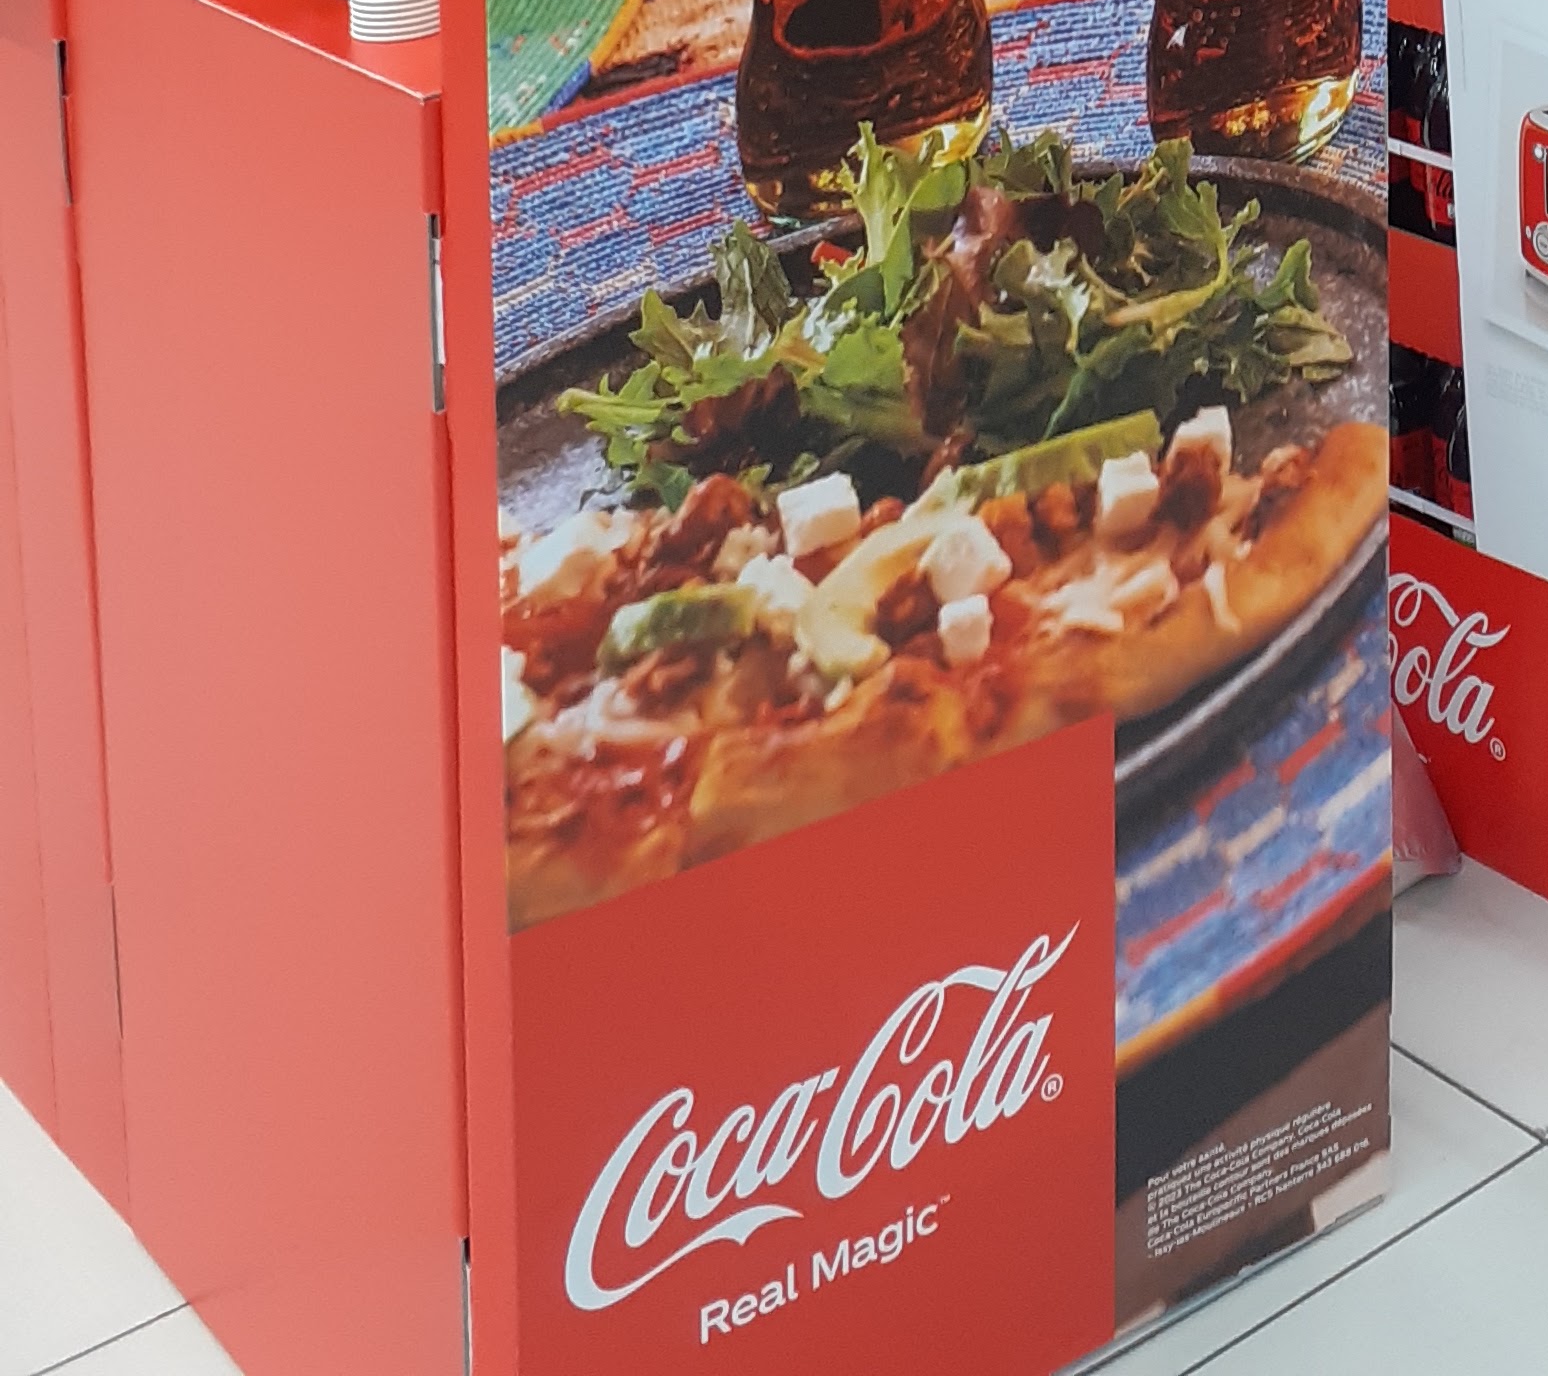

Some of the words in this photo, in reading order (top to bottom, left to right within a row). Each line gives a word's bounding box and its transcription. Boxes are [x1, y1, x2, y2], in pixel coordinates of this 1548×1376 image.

[565, 920, 1081, 1311] Coca-Cola
[1250, 1122, 1290, 1152] physique
[1148, 1172, 1169, 1189] Pour
[1172, 1158, 1196, 1176] votre
[698, 1278, 799, 1345] Real
